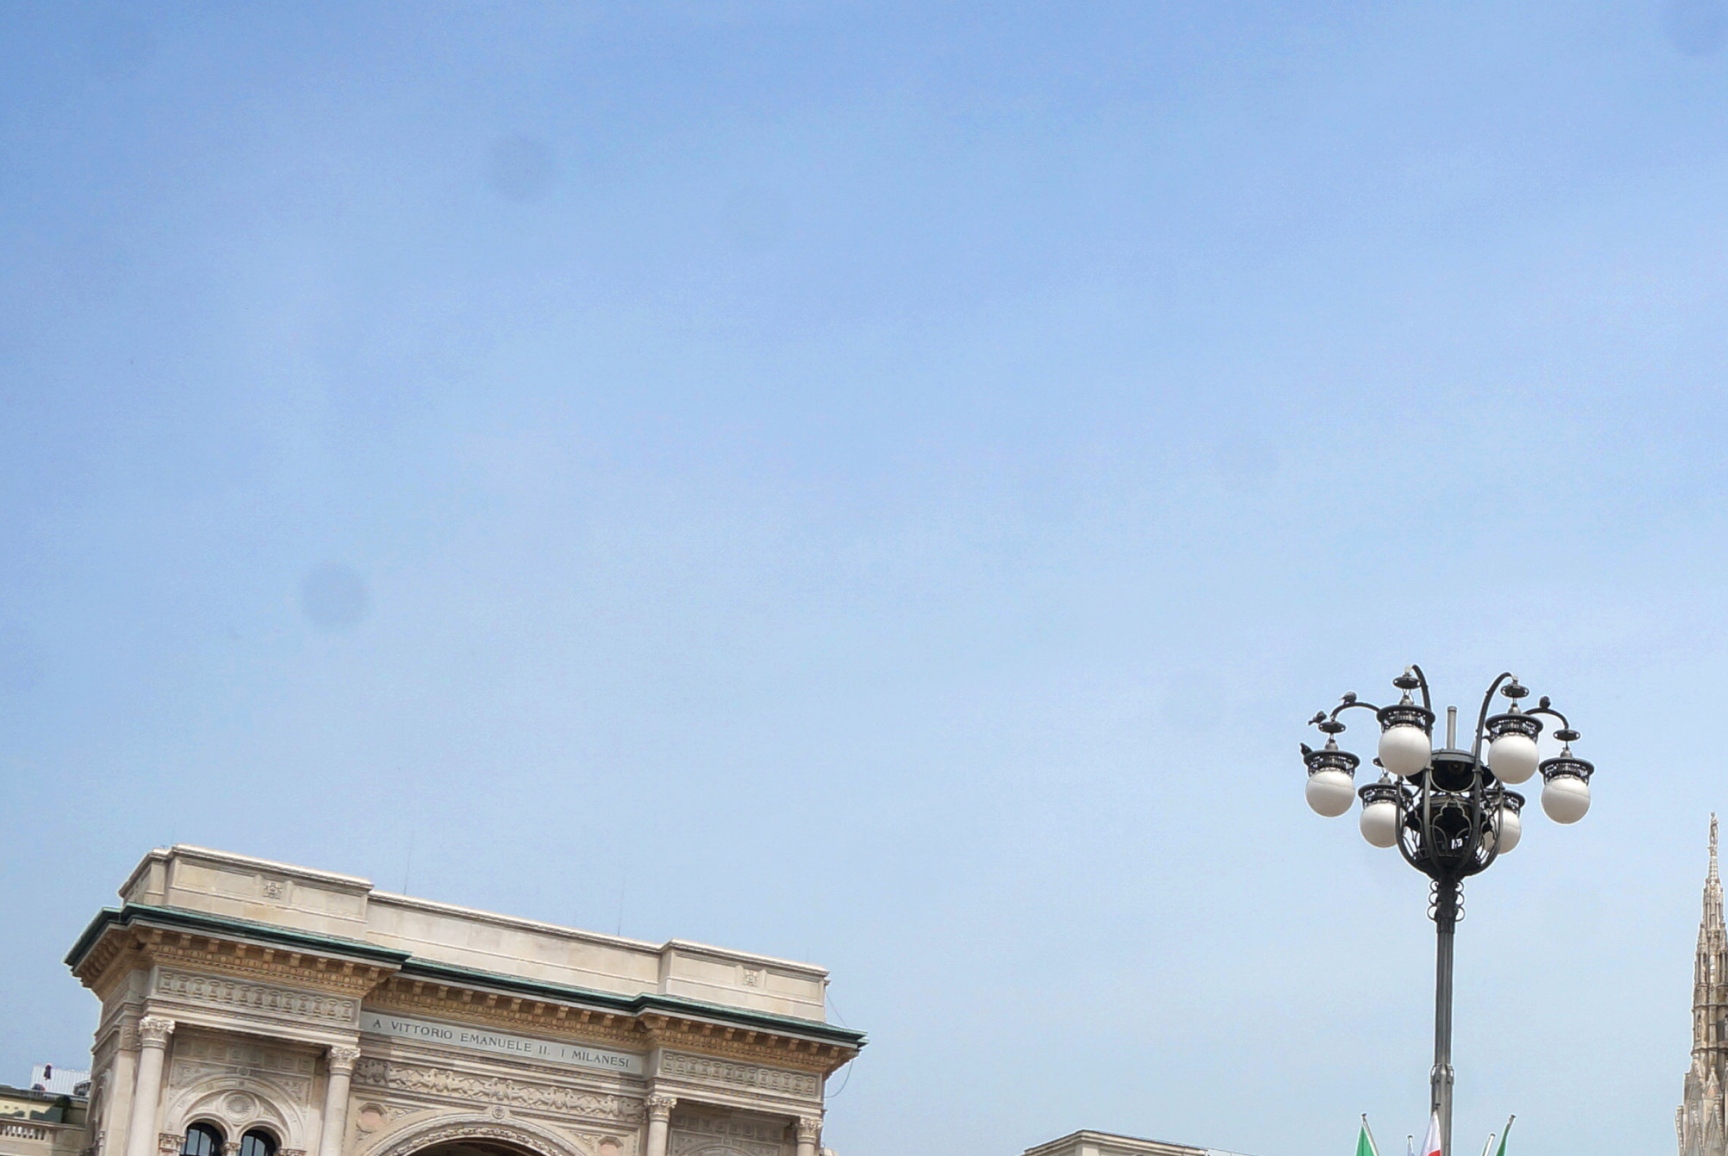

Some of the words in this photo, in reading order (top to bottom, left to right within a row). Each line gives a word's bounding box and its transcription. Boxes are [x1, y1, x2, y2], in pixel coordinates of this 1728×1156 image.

[373, 1019, 381, 1028] A
[391, 1021, 453, 1040] VITTORIO
[460, 1033, 532, 1053] EMANUELE
[572, 1050, 630, 1068] MILANESI
